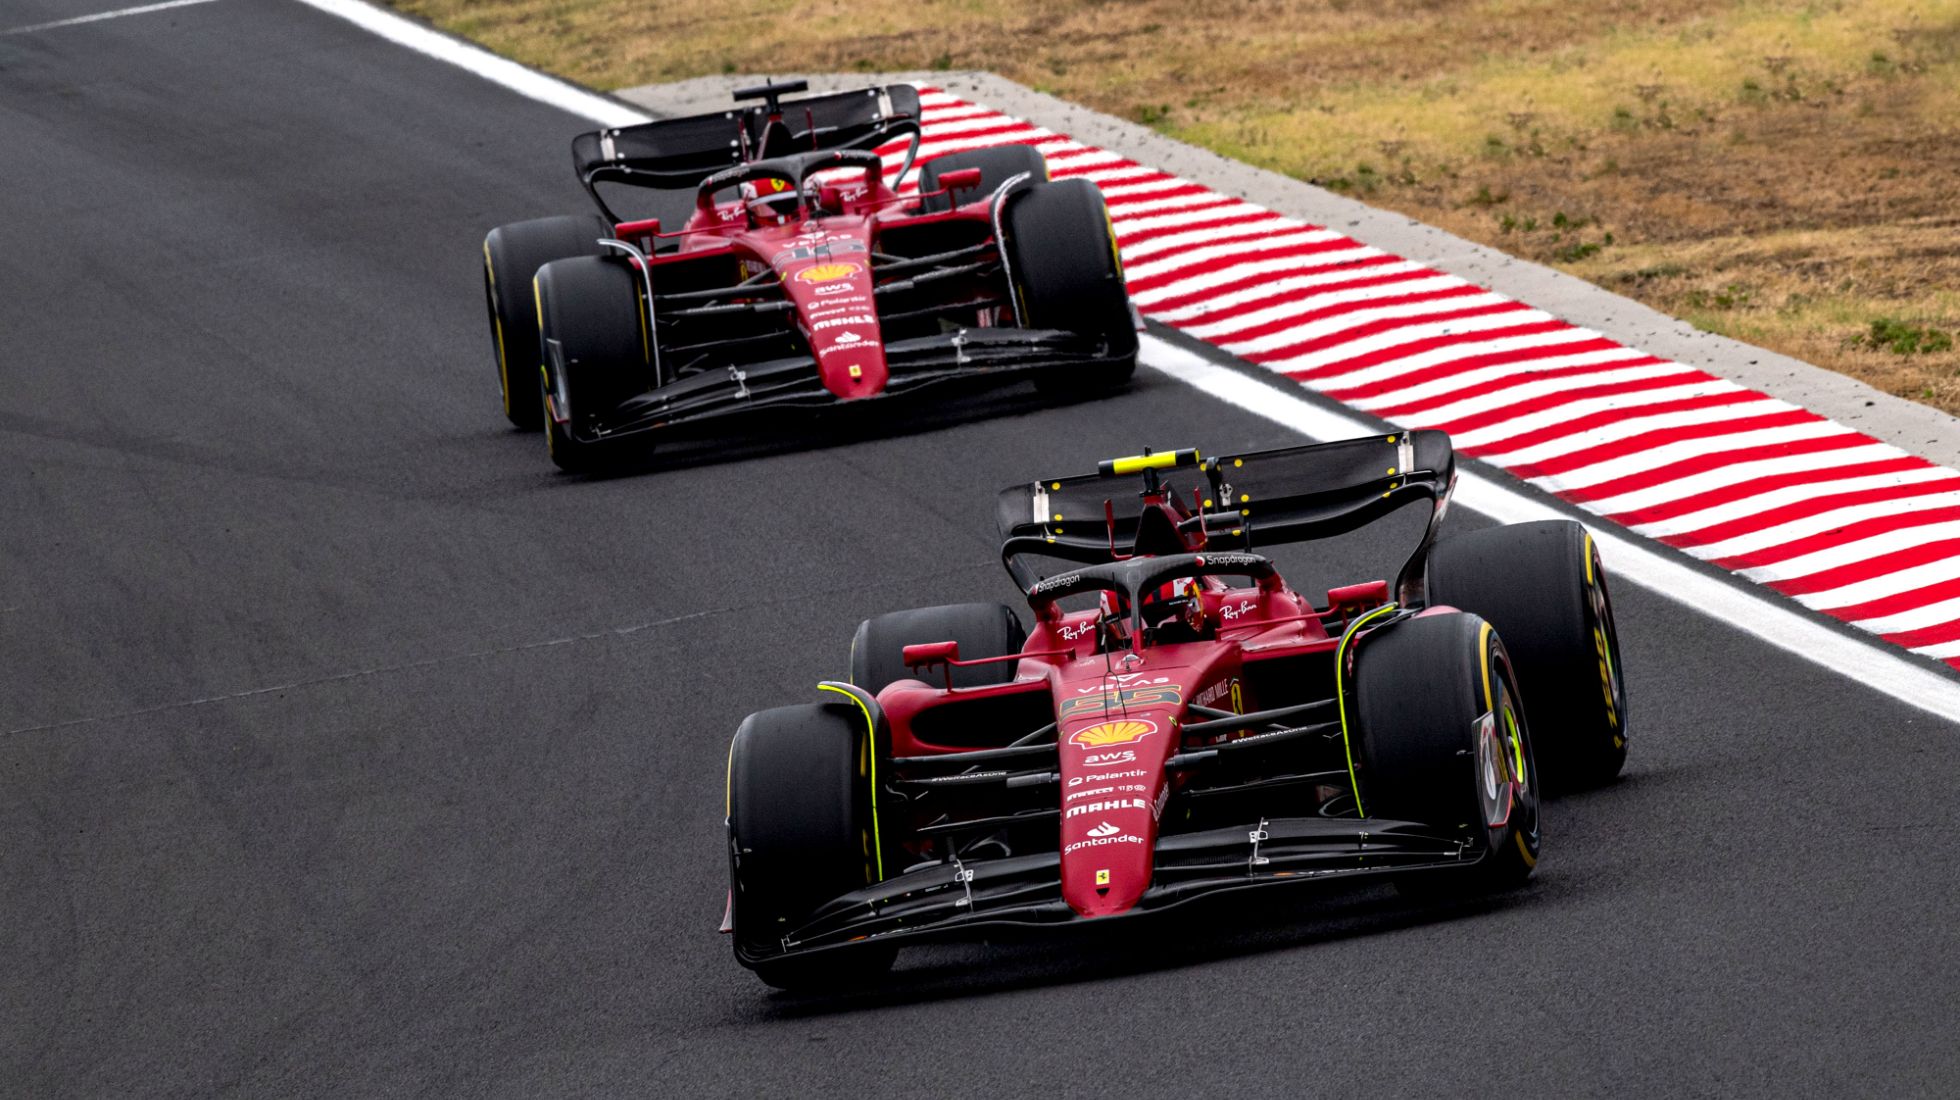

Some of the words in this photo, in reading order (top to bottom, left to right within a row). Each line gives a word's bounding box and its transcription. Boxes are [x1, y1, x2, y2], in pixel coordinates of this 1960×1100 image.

[813, 314, 874, 331] MAHLE
[1206, 554, 1257, 567] Snapdragon
[1038, 574, 1080, 592] Snapdragon
[1219, 600, 1257, 620] Ray-Ban
[1056, 621, 1096, 640] Ray-Ban
[1059, 684, 1182, 722] 55
[1083, 750, 1136, 767] aws
[1086, 769, 1147, 783] Palantir
[1066, 798, 1146, 819] MAHLE
[1064, 834, 1144, 856] santander
